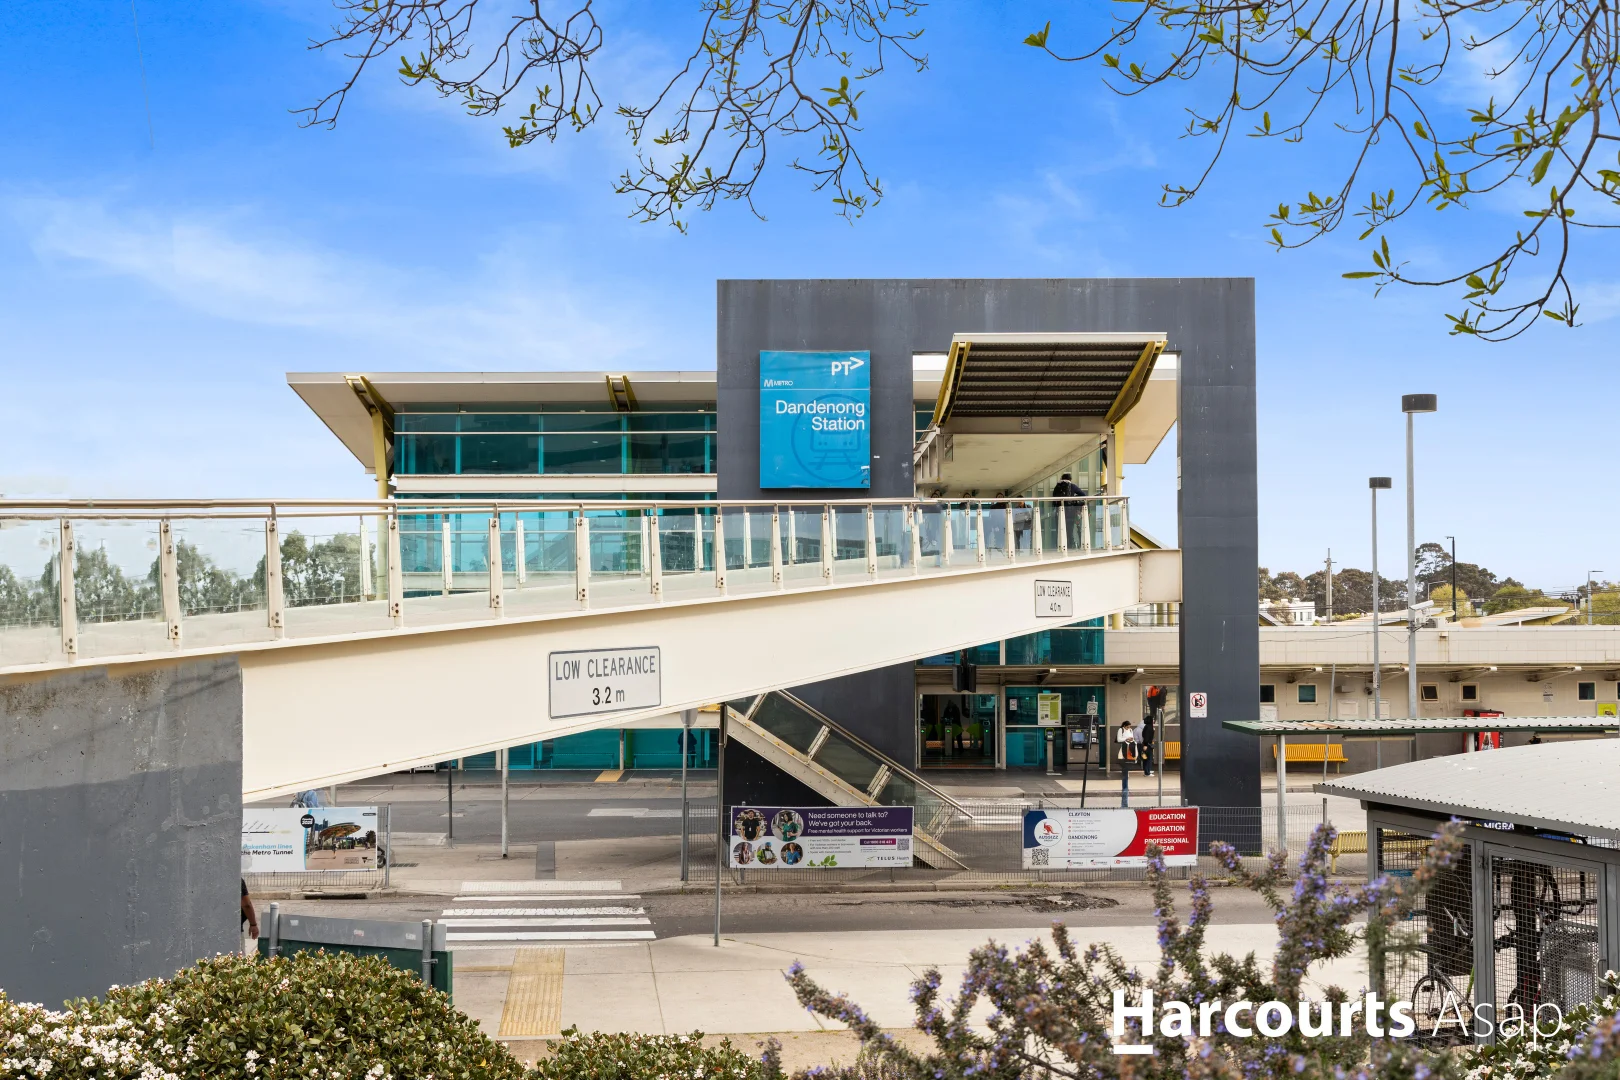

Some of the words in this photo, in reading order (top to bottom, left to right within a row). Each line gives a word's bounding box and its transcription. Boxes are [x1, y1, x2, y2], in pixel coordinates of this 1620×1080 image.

[775, 400, 865, 417] Dandenong
[811, 416, 865, 431] Station
[1047, 585, 1070, 597] CLEARANCE
[555, 660, 581, 681] LOW
[587, 655, 656, 679] CLEARANCE
[592, 686, 612, 706] 3.2
[615, 689, 625, 702] m
[1149, 813, 1186, 821] EDUCATION
[828, 820, 840, 828] got
[840, 820, 855, 828] your
[1148, 825, 1185, 833] MIGRATION
[1483, 822, 1515, 830] MIGRA
[1144, 837, 1190, 845] PROFESSIONAL
